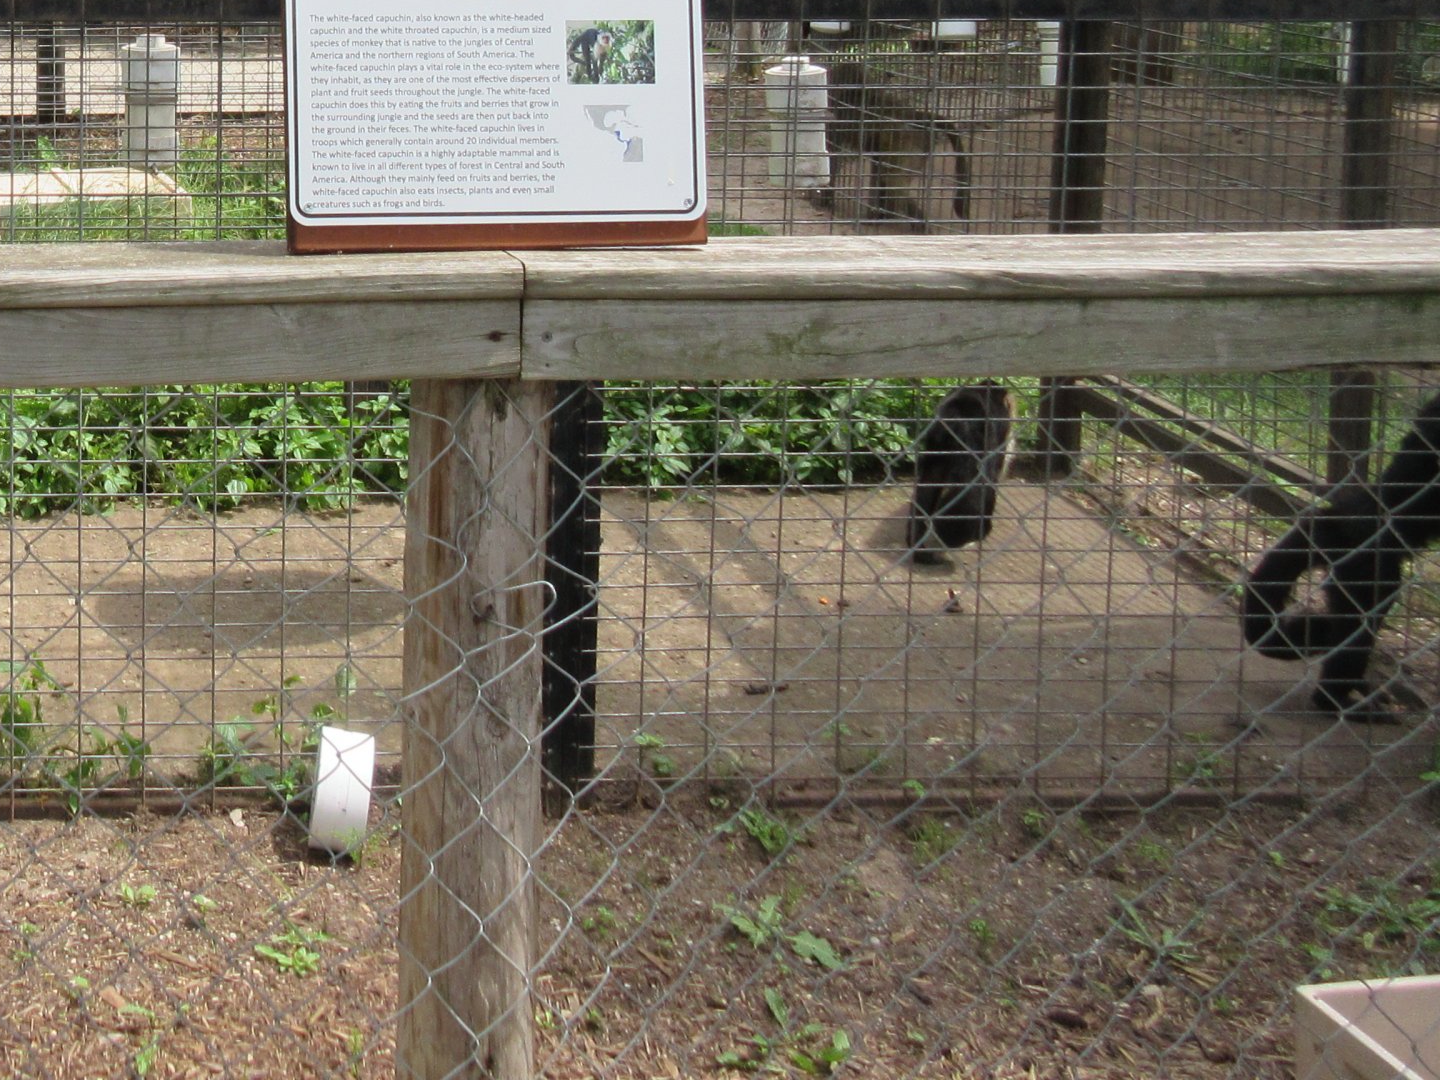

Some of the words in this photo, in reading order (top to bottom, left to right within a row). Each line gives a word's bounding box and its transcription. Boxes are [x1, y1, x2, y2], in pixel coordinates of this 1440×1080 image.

[310, 14, 325, 22] The
[326, 14, 374, 22] white-faced
[376, 13, 414, 24] capuchin,
[416, 13, 432, 21] also
[434, 13, 461, 21] known
[474, 13, 487, 21] the
[489, 13, 544, 21] white-headed
[310, 26, 346, 36] capuchin
[348, 26, 363, 34] and
[365, 26, 379, 34] the
[380, 26, 403, 34] white
[405, 26, 440, 34] throated
[441, 25, 480, 36] capuchin,
[482, 25, 488, 33] is
[497, 25, 530, 33] medium
[532, 25, 552, 33] sized
[310, 39, 340, 49] species
[341, 38, 350, 47] of
[352, 38, 384, 49] monkey
[385, 38, 402, 46] that
[404, 38, 410, 46] is
[412, 38, 437, 46] native
[448, 38, 462, 46] the
[464, 37, 493, 48] jungles
[494, 37, 503, 46] of
[505, 37, 534, 46] Central
[310, 51, 344, 59] America
[345, 51, 361, 59] and
[362, 51, 376, 59] the
[378, 50, 414, 59] northern
[416, 50, 445, 60] regions
[446, 50, 455, 58] of
[457, 50, 481, 58] South
[482, 50, 518, 58] America.
[520, 50, 535, 58] The
[310, 63, 358, 71] white-faced
[360, 63, 396, 73] capuchin
[398, 63, 418, 73] plays
[426, 62, 444, 71] vital
[445, 62, 461, 71] role
[463, 62, 471, 71] in
[473, 62, 486, 70] the
[488, 63, 533, 72] eco-system
[535, 62, 560, 70] where
[310, 76, 329, 86] they
[330, 75, 361, 85] inhabit,
[374, 75, 392, 86] they
[426, 75, 435, 83] of
[436, 75, 450, 83] the
[474, 74, 508, 83] effective
[510, 74, 550, 84] dispersers
[552, 74, 561, 82] of
[311, 88, 332, 98] plant
[334, 88, 349, 96] and
[351, 88, 368, 96] fruit
[370, 88, 393, 96] seeds
[395, 87, 440, 98] throughout
[442, 87, 456, 95] the
[457, 87, 485, 97] jungle.
[486, 87, 502, 95] The
[503, 87, 551, 95] white-faced
[311, 100, 347, 111] capuchin
[349, 100, 369, 108] does
[370, 100, 385, 108] this
[387, 100, 397, 110] by
[399, 100, 424, 110] eating
[425, 100, 439, 108] the
[440, 99, 462, 108] fruits
[464, 99, 479, 108] and
[481, 99, 509, 107] berries
[511, 99, 528, 107] that
[530, 101, 550, 109] grow
[551, 99, 559, 107] in
[312, 113, 325, 121] the
[327, 113, 376, 123] surrounding
[377, 112, 402, 123] jungle
[404, 112, 419, 120] and
[421, 112, 434, 120] the
[436, 112, 459, 120] seeds
[476, 112, 495, 120] then
[497, 112, 511, 122] put
[512, 111, 531, 120] back
[533, 111, 549, 119] into
[312, 125, 325, 133] the
[327, 125, 356, 135] ground
[358, 125, 366, 133] in
[368, 125, 387, 133] their
[388, 125, 411, 133] feces.
[413, 124, 429, 133] The
[430, 124, 478, 132] white-faced
[480, 124, 516, 134] capuchin
[518, 124, 535, 132] lives
[537, 123, 545, 132] in
[312, 139, 338, 148] troops
[340, 137, 364, 146] which
[366, 137, 402, 147] generally
[404, 137, 434, 145] contain
[436, 136, 465, 145] around
[466, 136, 477, 145] 20
[478, 136, 518, 144] individual
[520, 136, 559, 144] members.
[312, 150, 327, 158] The
[329, 150, 376, 158] white-faced
[378, 149, 414, 160] capuchin
[416, 149, 422, 157] is
[431, 149, 456, 159] highly
[457, 149, 497, 159] adaptable
[499, 148, 535, 157] mammal
[536, 148, 552, 156] and
[553, 148, 560, 156] is
[312, 175, 348, 183] America.
[350, 174, 387, 185] Although
[388, 174, 407, 184] they
[408, 174, 435, 184] mainly
[437, 174, 455, 182] feed
[470, 173, 491, 182] fruits
[492, 173, 508, 181] and
[510, 173, 540, 182] berries,
[542, 173, 556, 181] the
[312, 187, 360, 195] white-faced
[362, 187, 398, 197] capuchin
[400, 186, 416, 195] also
[436, 186, 467, 195] insects,
[469, 186, 494, 196] plants
[495, 185, 511, 194] and
[534, 185, 555, 193] small
[312, 200, 351, 208] creatures
[352, 199, 371, 207] such
[383, 199, 404, 209] frogs
[406, 199, 421, 207] and
[423, 198, 446, 207] birds.
